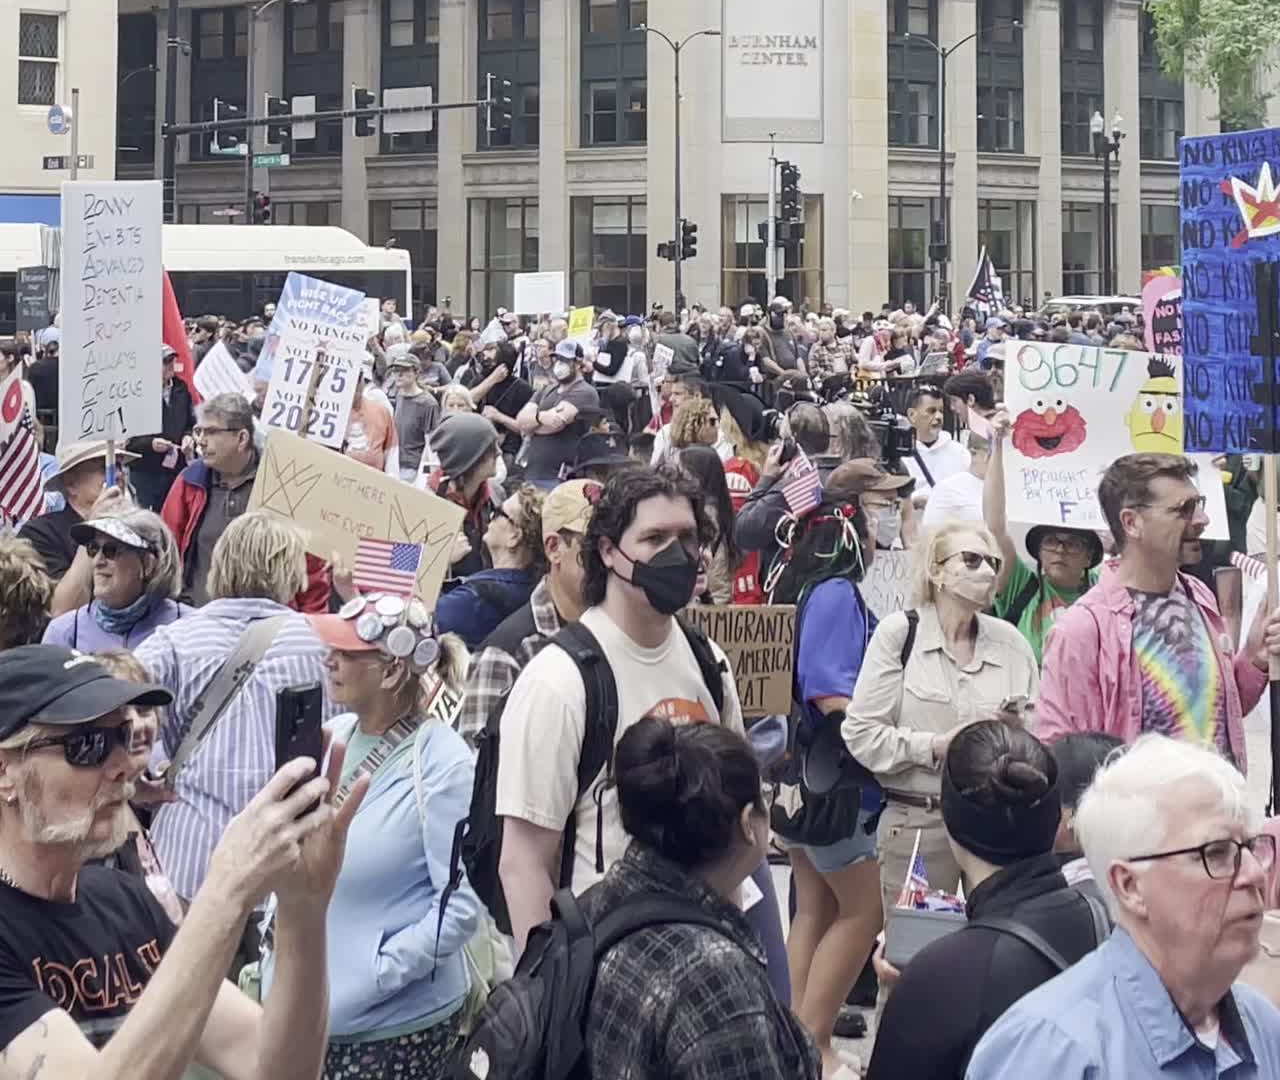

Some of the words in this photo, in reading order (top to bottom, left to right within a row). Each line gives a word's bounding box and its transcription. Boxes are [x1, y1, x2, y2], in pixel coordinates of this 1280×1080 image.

[728, 35, 817, 49] BURNHAM
[741, 52, 808, 66] CENTER
[1184, 140, 1216, 168] NO
[1221, 136, 1266, 166] KINGS
[1183, 177, 1213, 209] NO
[1183, 219, 1215, 251] NO
[1184, 262, 1211, 299] NO
[287, 299, 320, 313] FIGHT
[322, 305, 353, 323] BACK
[330, 294, 346, 308] UP
[1155, 304, 1175, 318] NO
[290, 319, 310, 332] NO
[1185, 313, 1209, 356] NO
[285, 346, 311, 359] NOT
[1018, 345, 1128, 392] 8647
[1185, 364, 1211, 401] NO
[276, 389, 303, 404] NOT
[268, 401, 338, 439] 2025
[1184, 412, 1212, 450] NO
[334, 472, 358, 489] NOT
[1022, 469, 1088, 488] BROUGHT
[1047, 487, 1070, 500] THE
[320, 508, 340, 521] NOT
[1058, 500, 1079, 523] F
[736, 647, 792, 677] AMERICA
